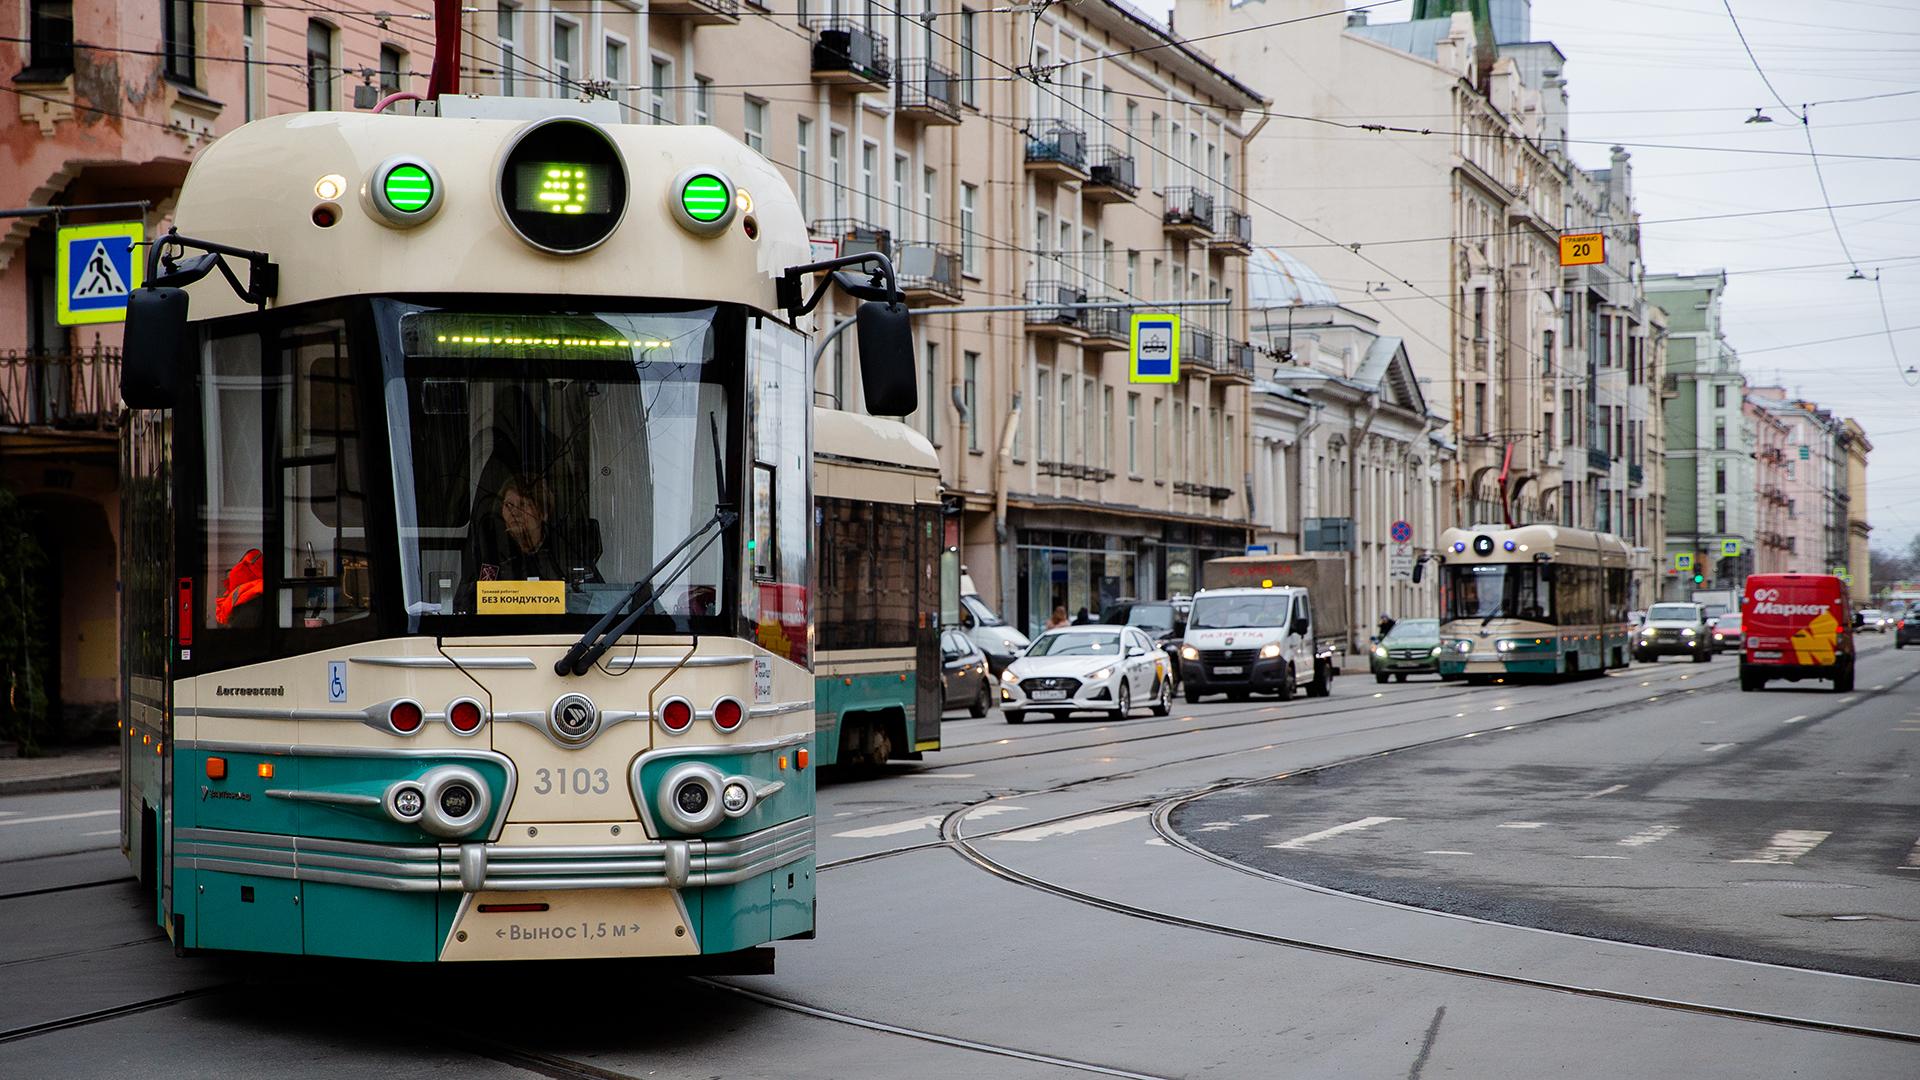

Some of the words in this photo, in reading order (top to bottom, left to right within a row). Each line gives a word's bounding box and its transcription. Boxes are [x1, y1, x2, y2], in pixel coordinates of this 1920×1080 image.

[1573, 244, 1590, 257] 20
[500, 596, 560, 604] КОНДУКТОРА
[1753, 602, 1830, 616] Маркет
[1200, 631, 1264, 639] РАЗМЕТКА
[534, 768, 609, 794] 3103
[510, 924, 577, 940] Вынос
[582, 922, 607, 940] 1,5
[612, 925, 626, 937] м
